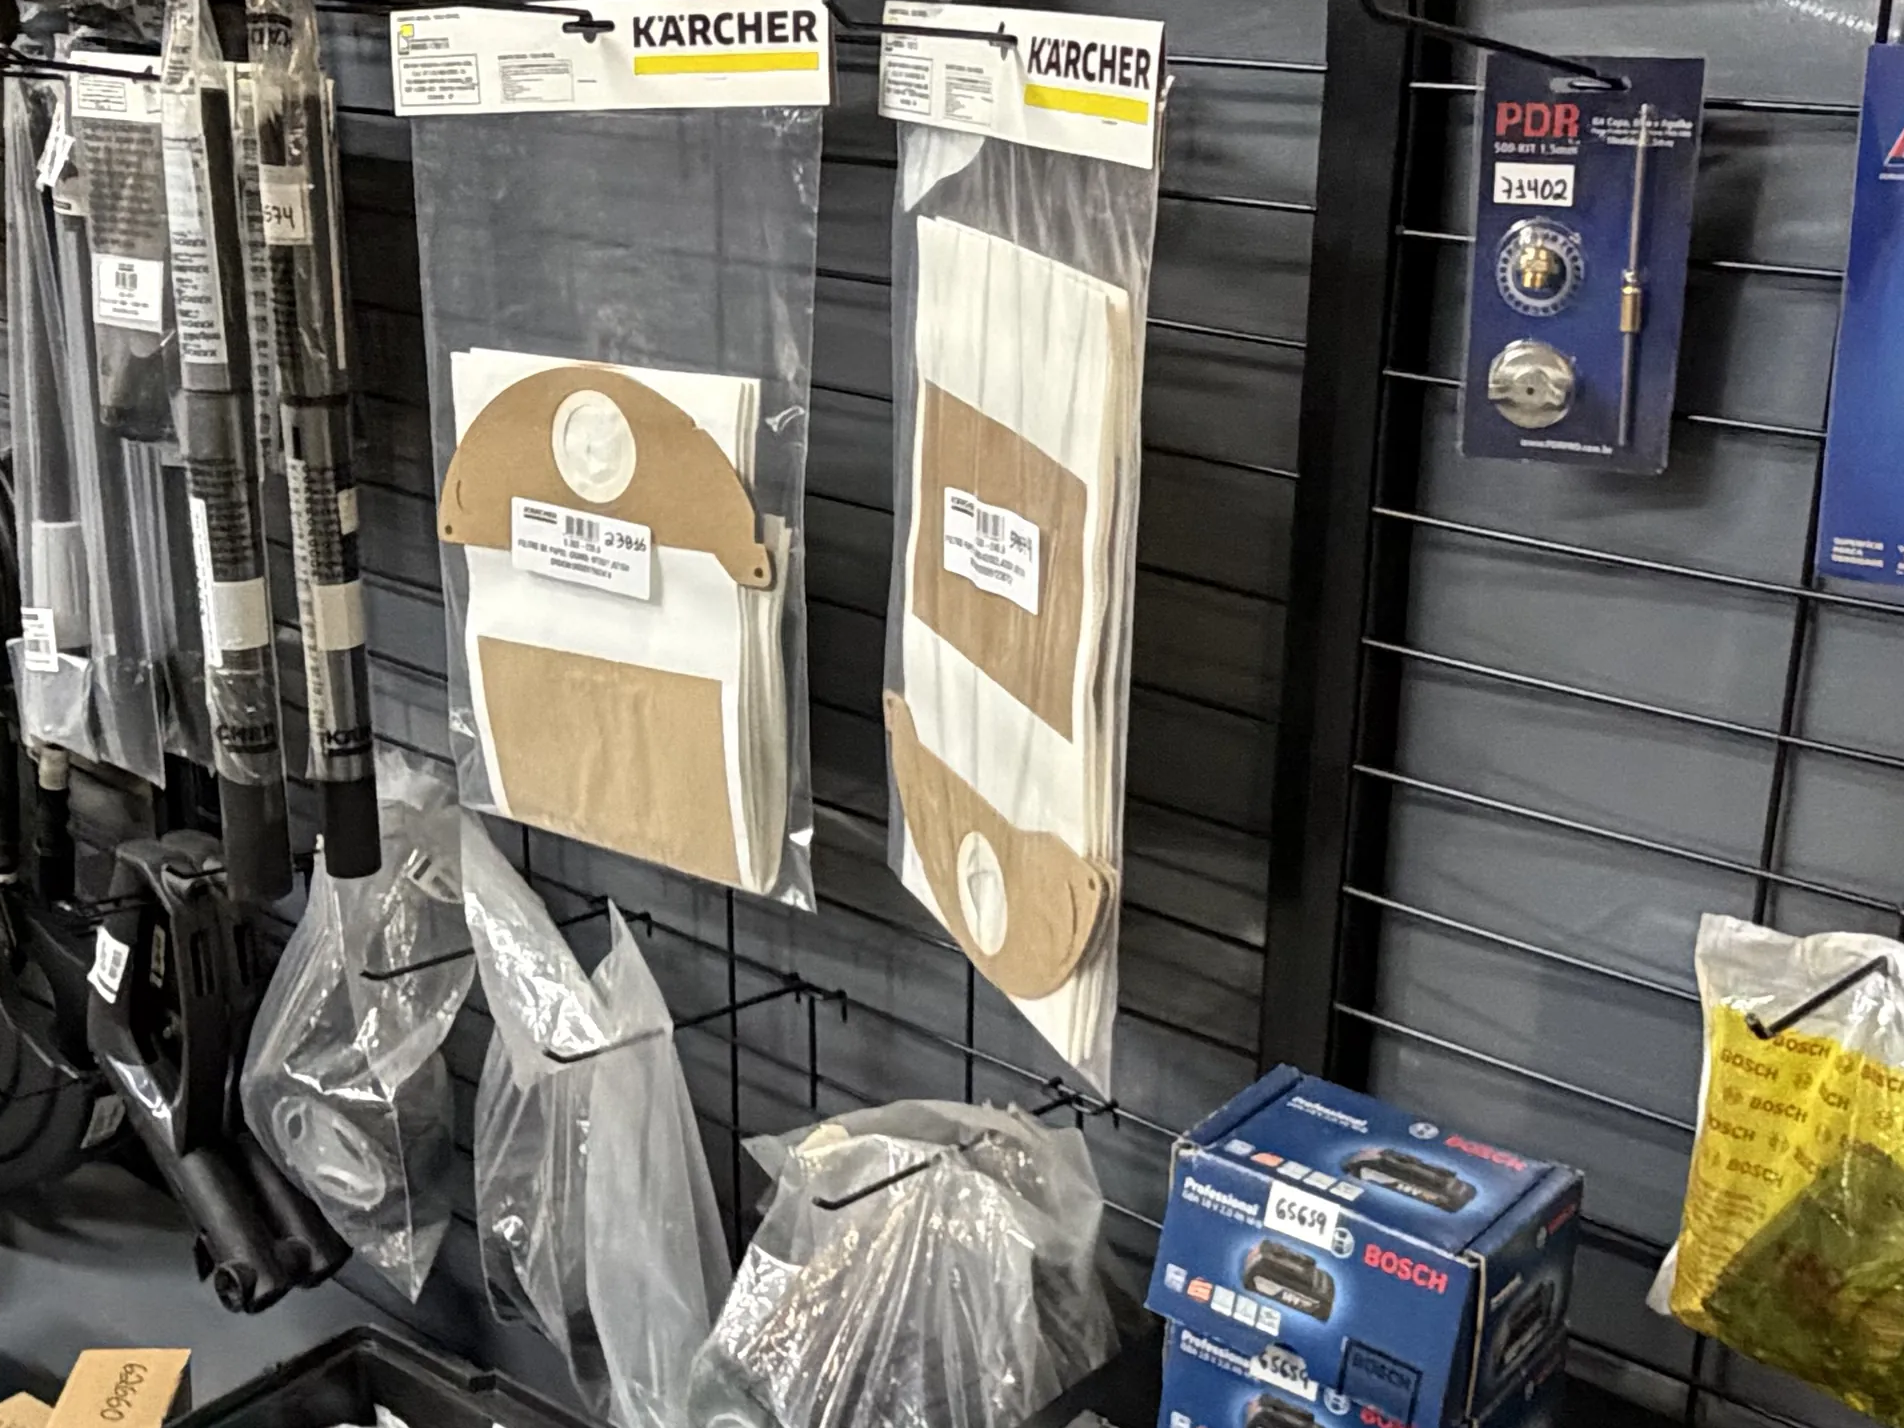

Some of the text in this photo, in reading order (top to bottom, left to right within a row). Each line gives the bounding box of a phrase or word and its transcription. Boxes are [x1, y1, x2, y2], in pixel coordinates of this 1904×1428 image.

[633, 9, 818, 49] KÄRCHER
[1027, 36, 1152, 90] KÄRCHER
[1496, 101, 1580, 138] PDR
[1500, 176, 1568, 201] 71402
[1721, 1048, 1779, 1082] BOSCH
[1749, 1096, 1808, 1124] BOSCH
[1726, 1157, 1784, 1189] BOSCH
[1184, 1176, 1260, 1217] Professional
[1363, 1243, 1449, 1295] BOSCH
